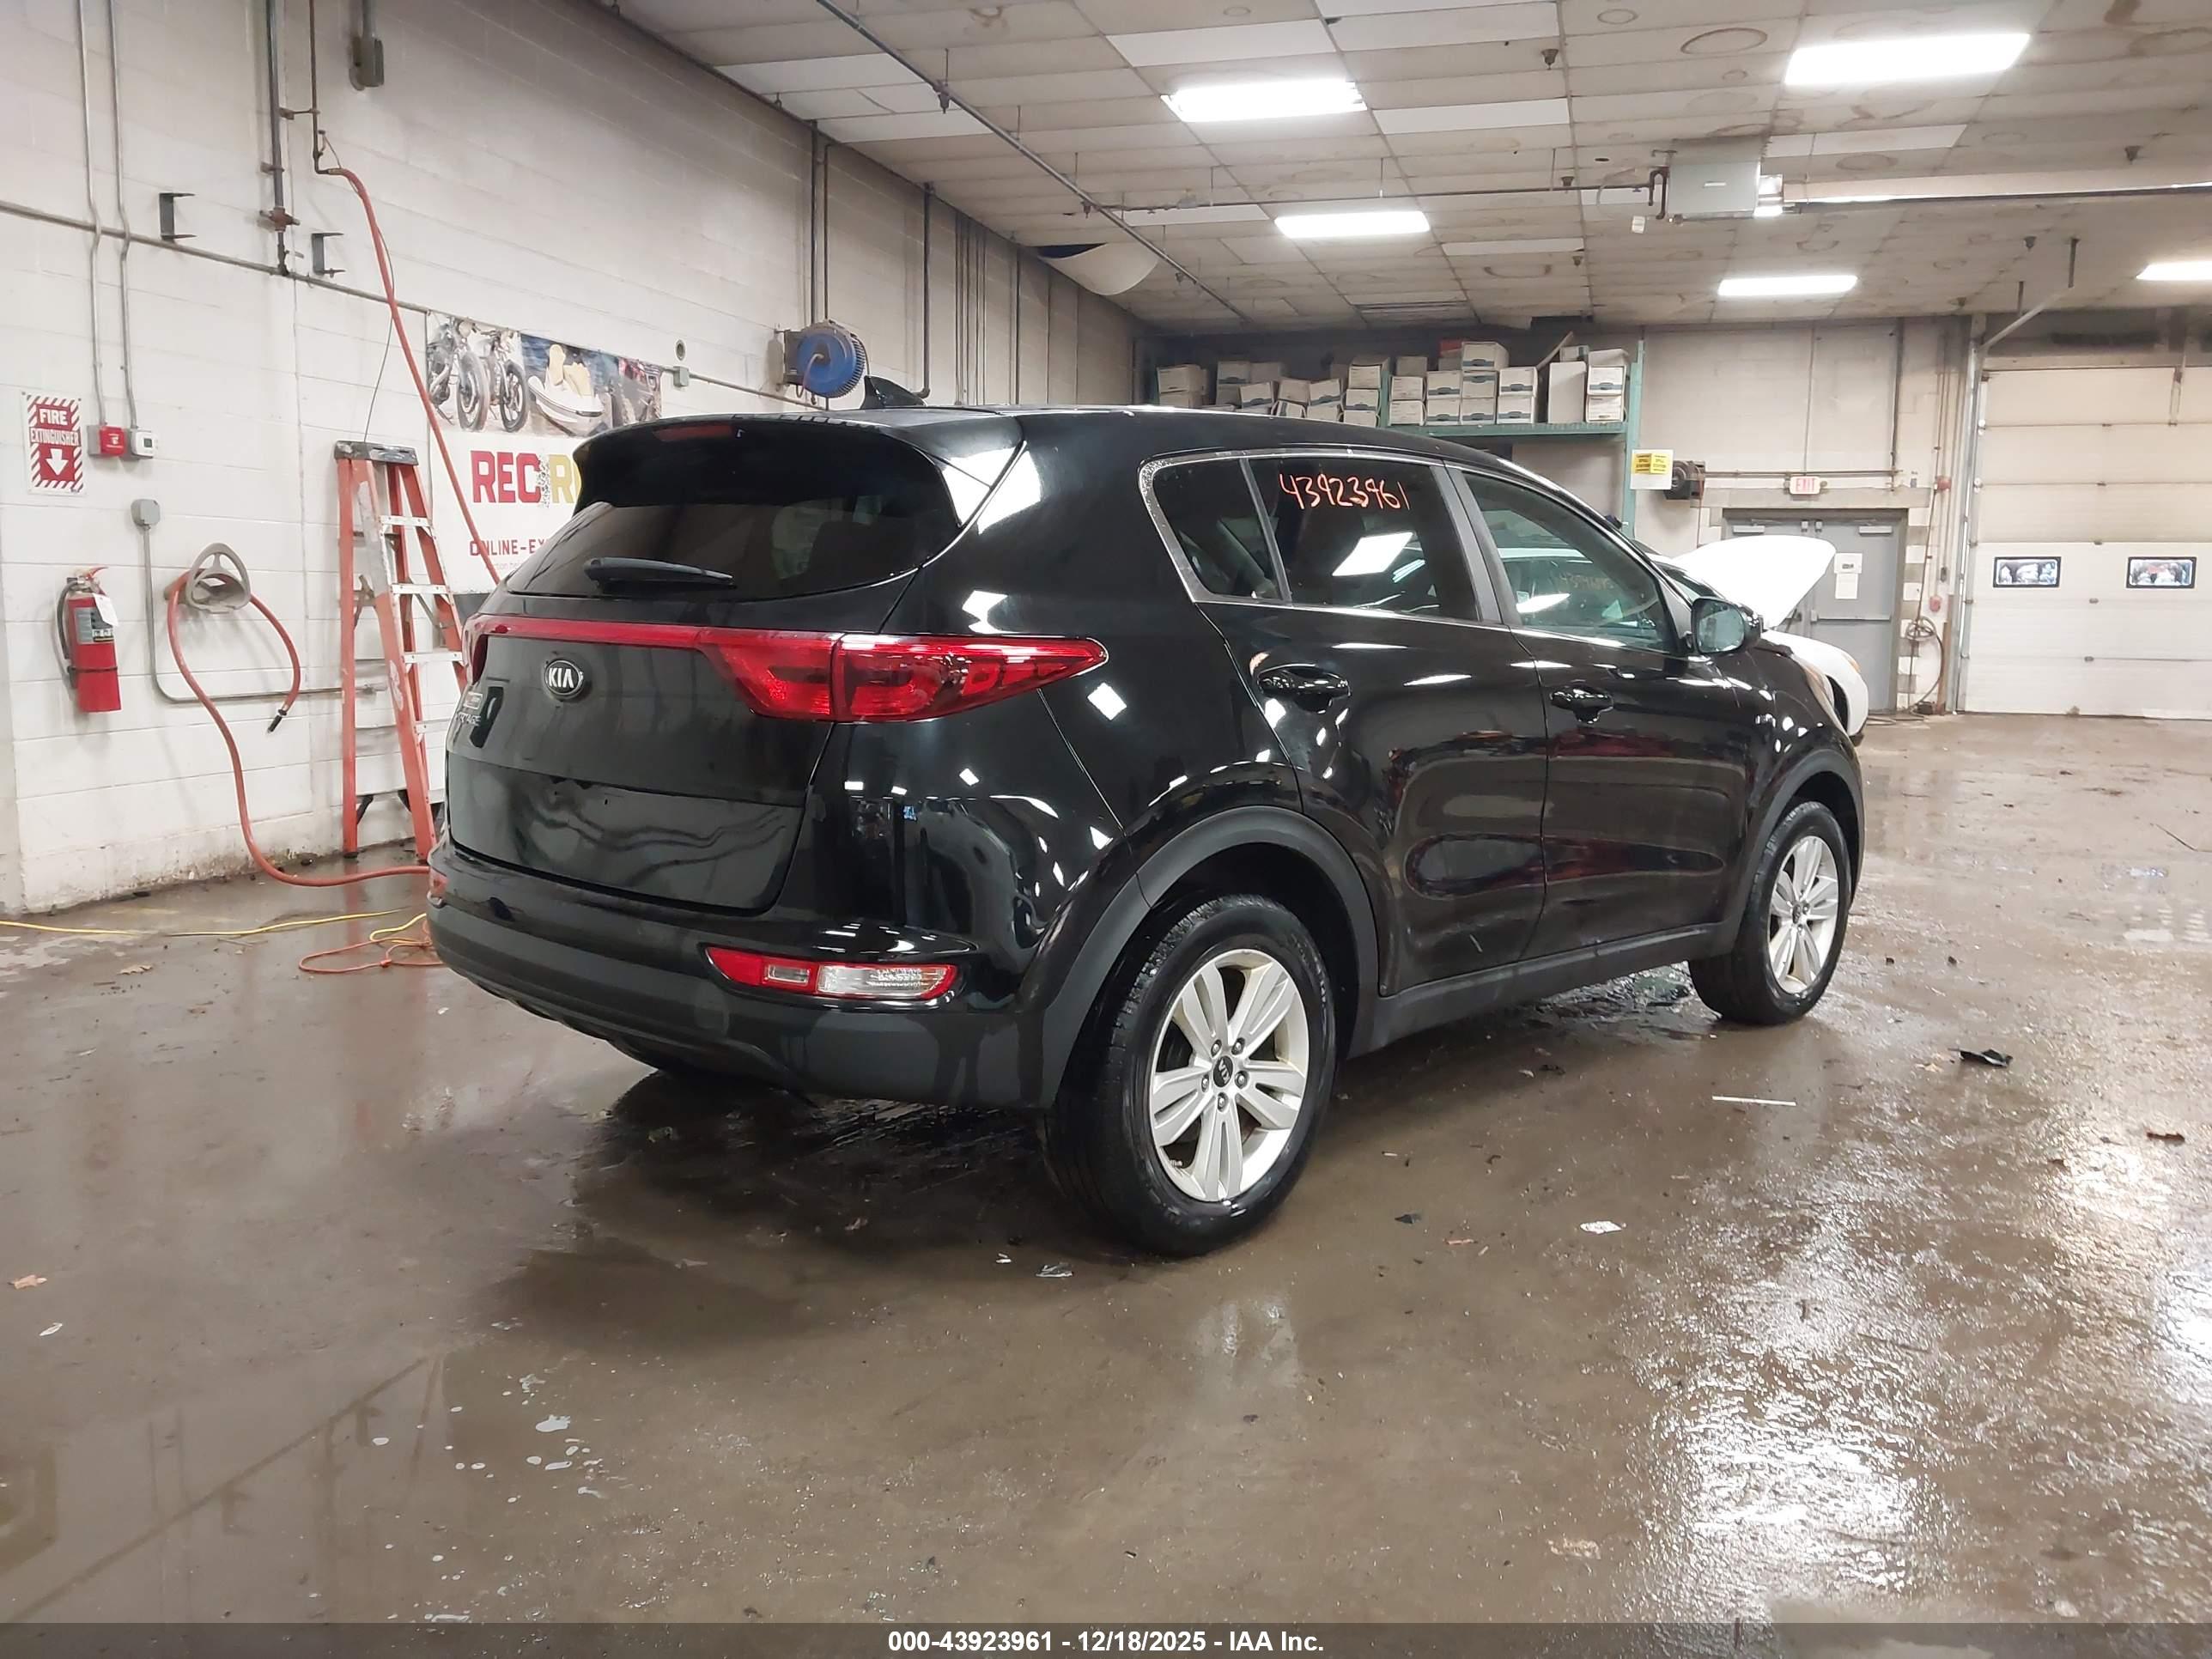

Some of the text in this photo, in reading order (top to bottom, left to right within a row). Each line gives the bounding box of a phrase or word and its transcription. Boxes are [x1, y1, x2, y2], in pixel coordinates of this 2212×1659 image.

[39, 408, 68, 425] FIRE
[30, 428, 80, 446] EXTINGUISHER
[1279, 473, 1411, 510] 43923961
[1796, 477, 1816, 492] EXIT
[548, 667, 574, 689] KIA
[1218, 1057, 1231, 1085] KIA
